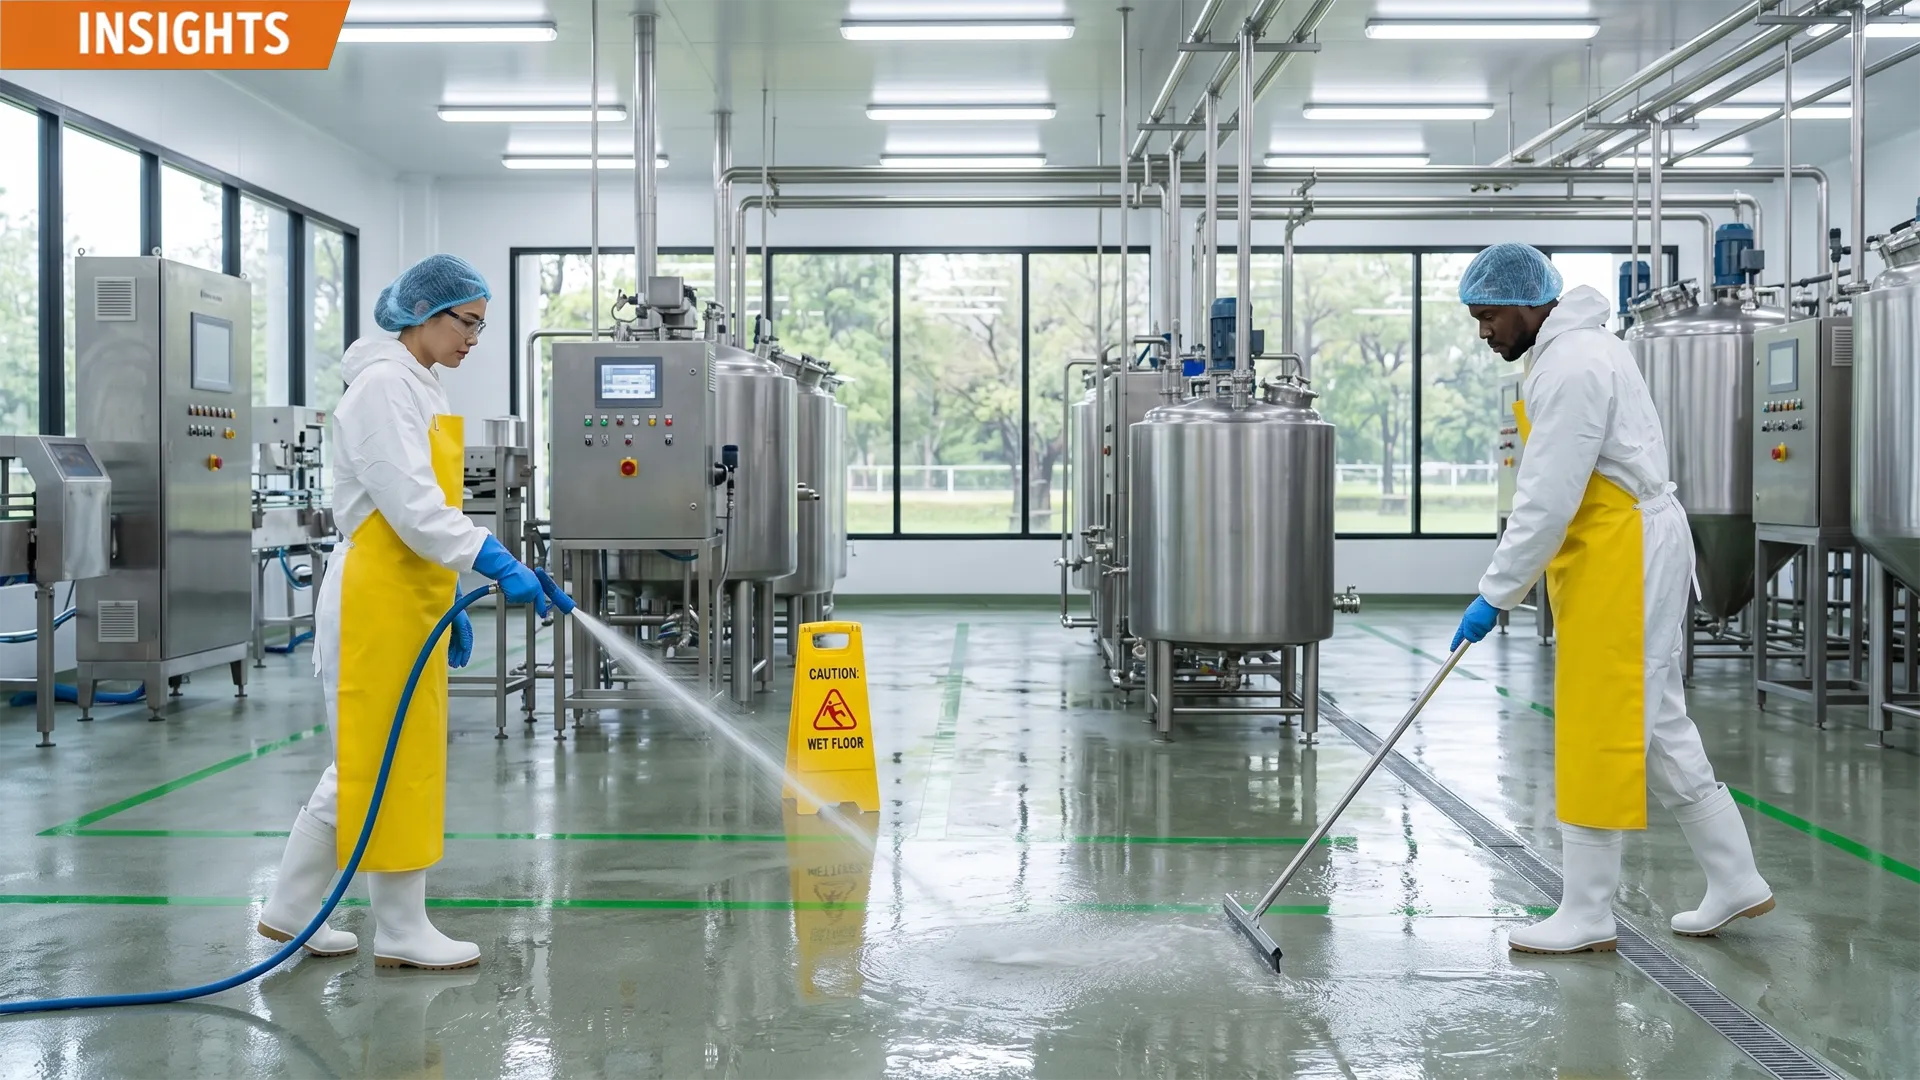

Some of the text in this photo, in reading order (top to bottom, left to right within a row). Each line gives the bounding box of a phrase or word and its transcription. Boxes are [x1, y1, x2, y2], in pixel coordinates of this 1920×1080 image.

[809, 667, 859, 680] CAUTION:
[807, 736, 864, 750] WET FLOOR
